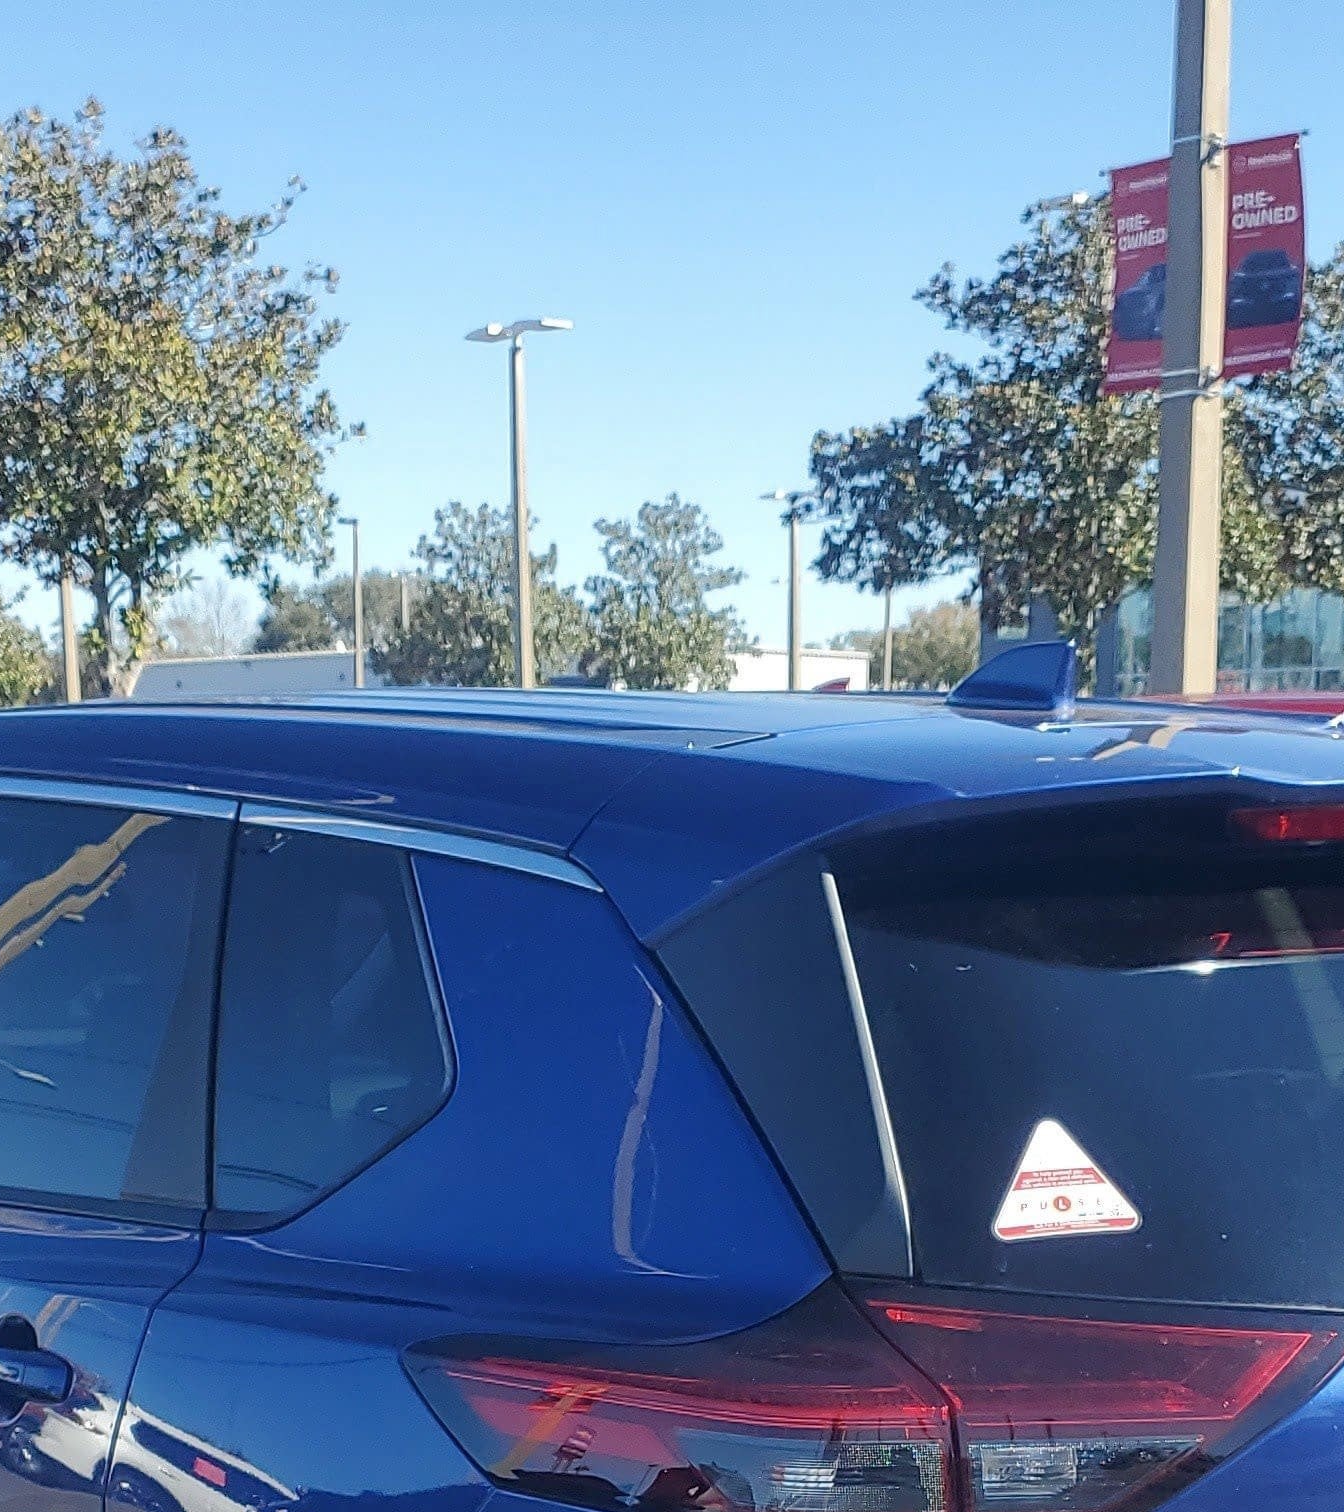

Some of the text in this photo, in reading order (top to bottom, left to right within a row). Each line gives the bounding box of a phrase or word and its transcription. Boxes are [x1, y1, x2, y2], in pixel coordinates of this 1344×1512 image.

[1232, 190, 1275, 212] PRE-
[1117, 214, 1150, 234] PRE-
[1232, 206, 1298, 230] OWNED
